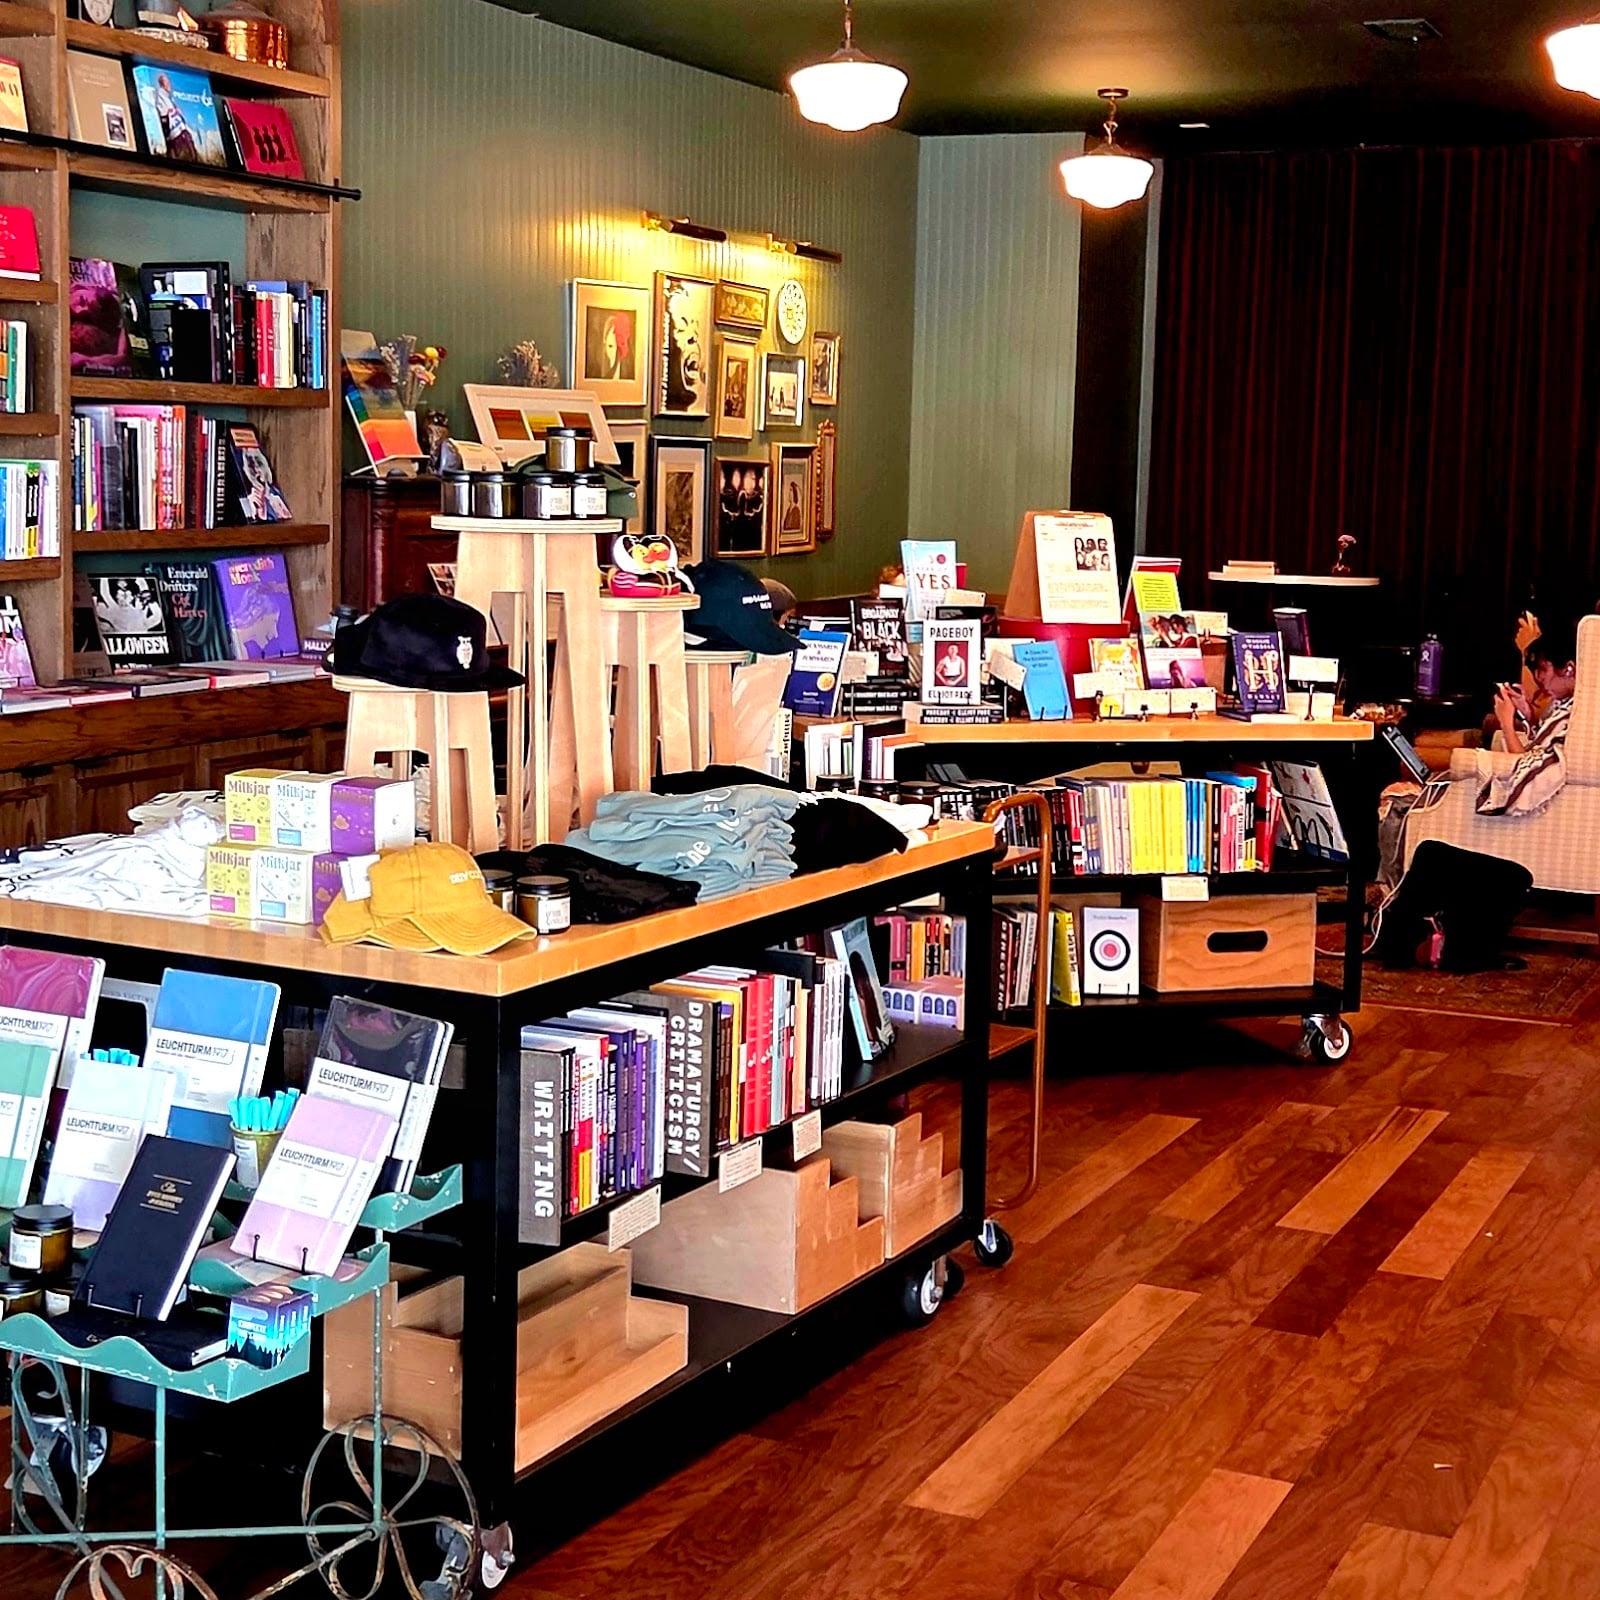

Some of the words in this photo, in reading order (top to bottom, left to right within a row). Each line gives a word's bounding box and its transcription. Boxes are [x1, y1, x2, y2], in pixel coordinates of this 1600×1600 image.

[167, 567, 208, 579] Emerald
[916, 573, 951, 590] YES
[160, 580, 198, 592] Drifters
[862, 621, 901, 640] BLACK
[930, 627, 974, 638] PAGEBOY
[228, 780, 270, 797] Milkjar
[277, 784, 317, 801] Milkjar
[209, 851, 251, 869] Milkjar
[260, 855, 301, 873] Milkjar
[667, 1015, 686, 1156] CRITICISM
[682, 1001, 704, 1173] DRAMATURGY/
[533, 1080, 555, 1218] WRITING
